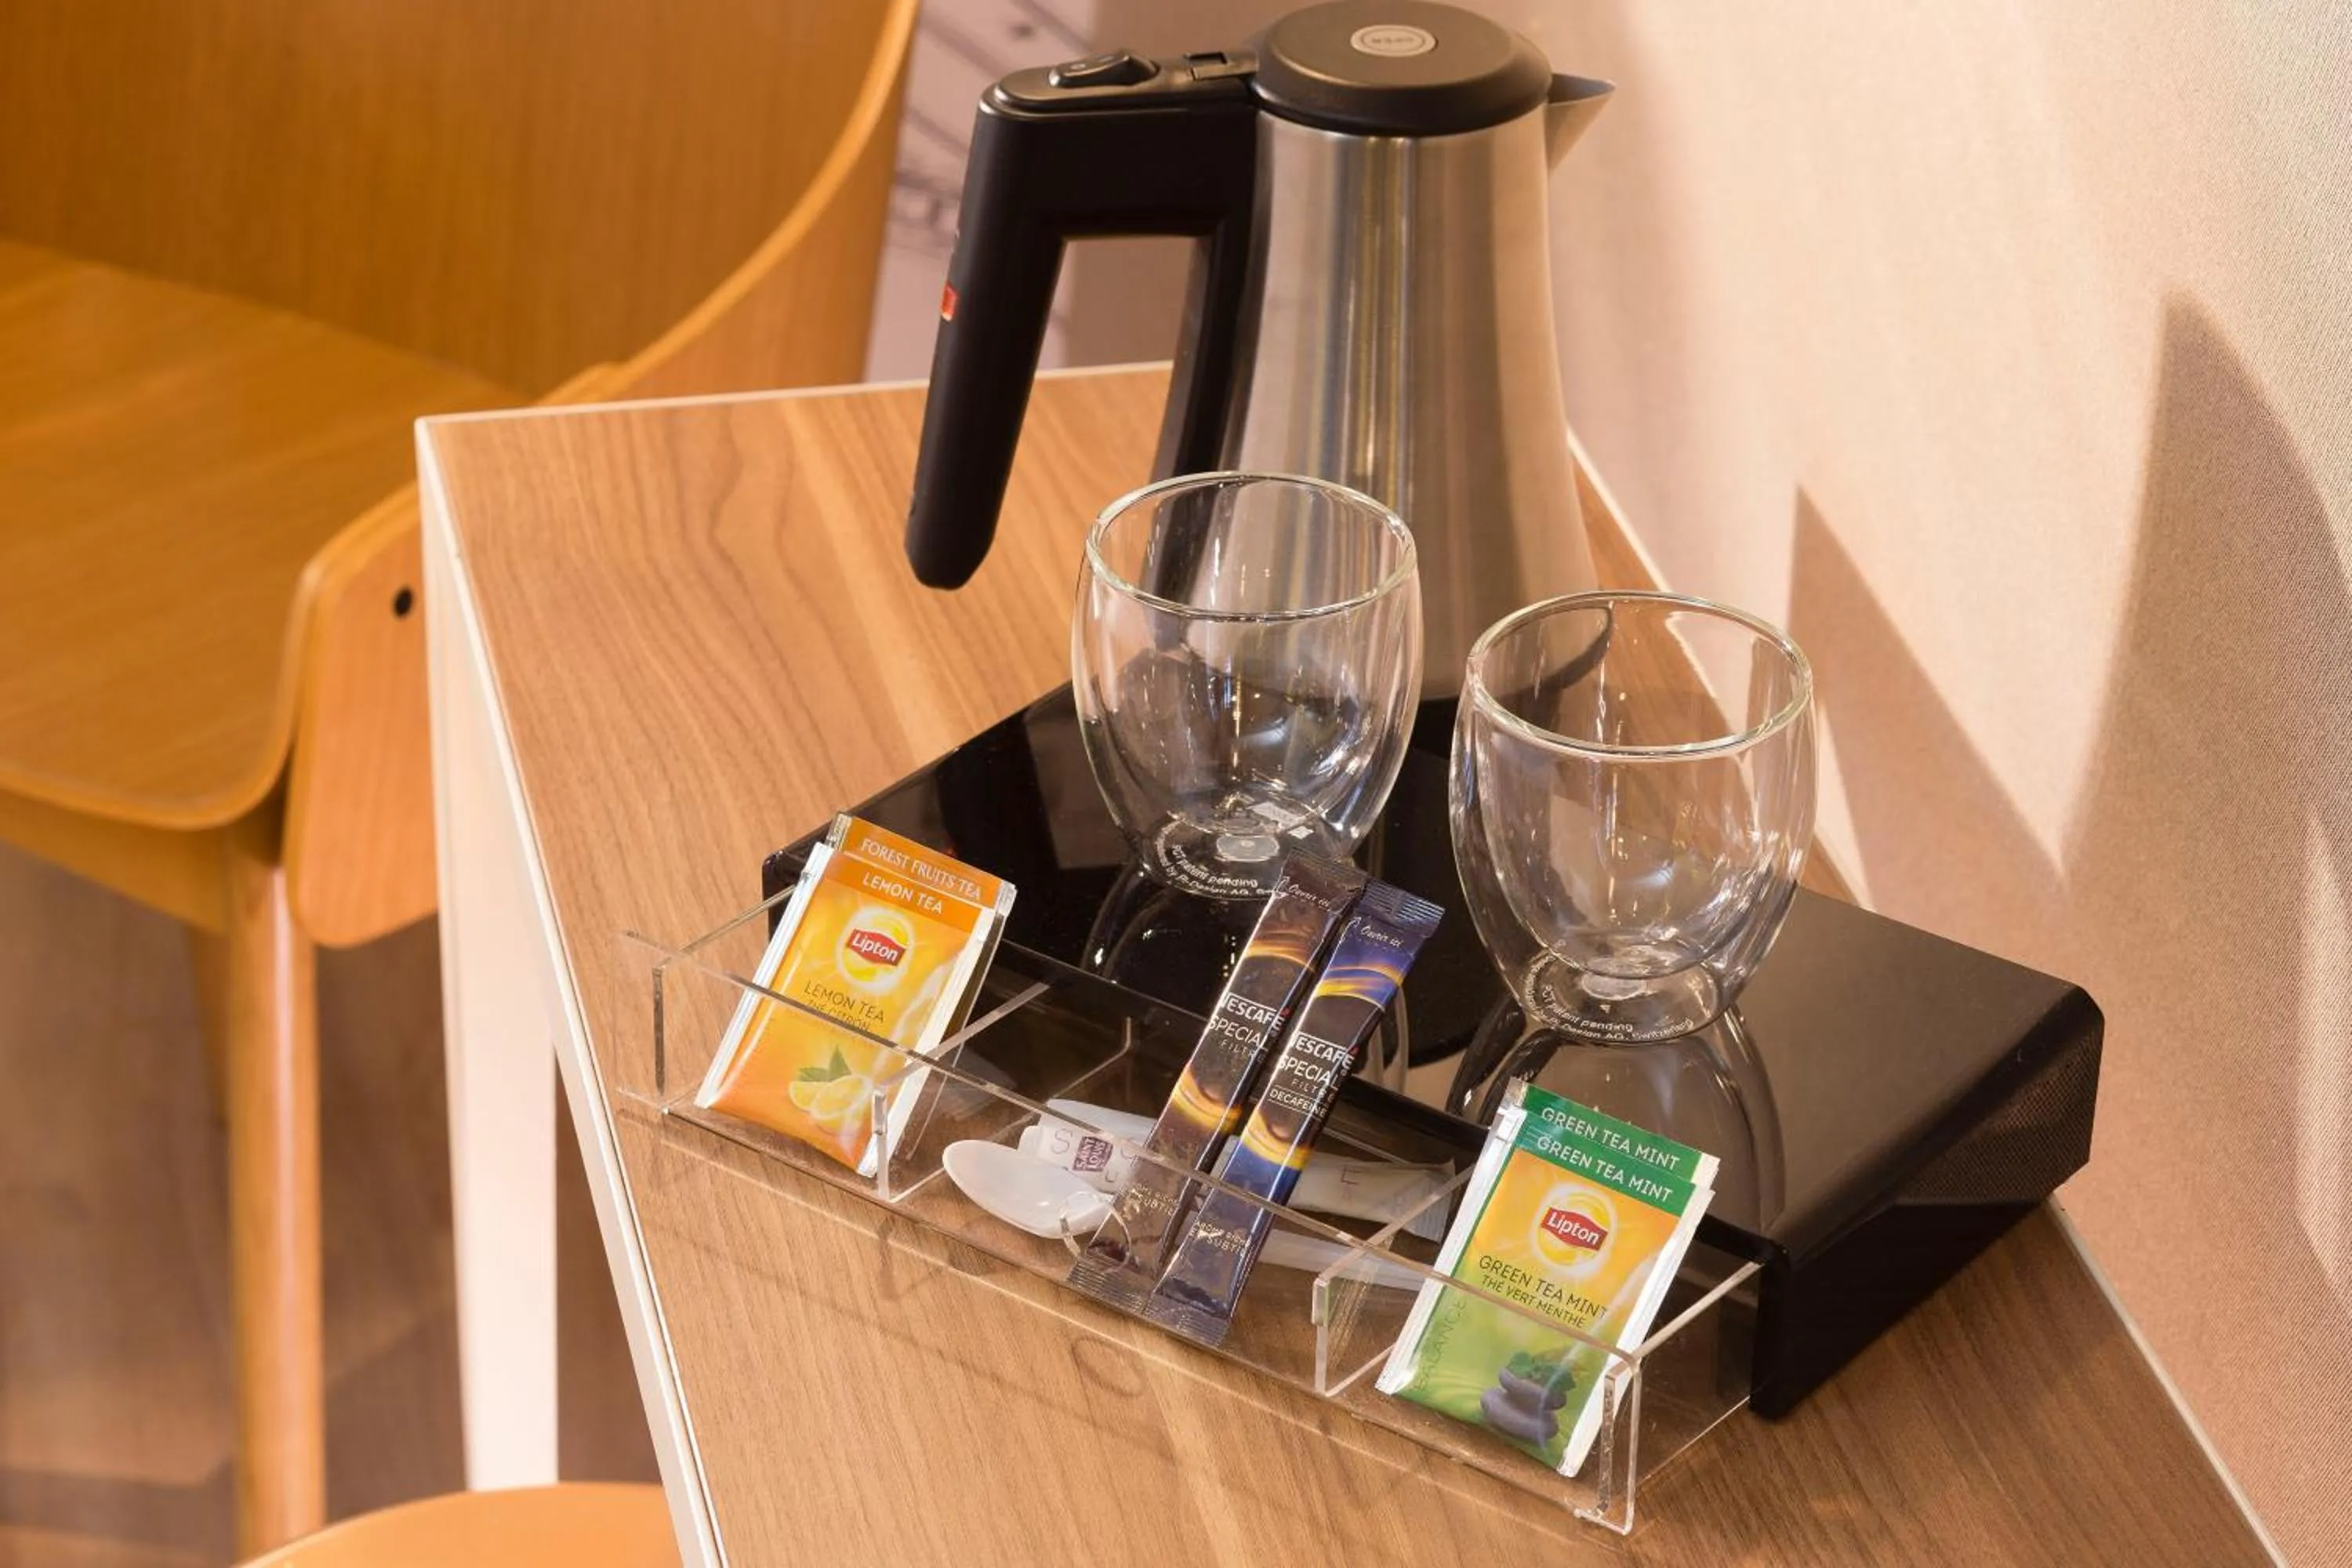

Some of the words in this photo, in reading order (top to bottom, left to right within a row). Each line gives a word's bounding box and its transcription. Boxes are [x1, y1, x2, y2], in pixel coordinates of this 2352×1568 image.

[861, 838, 909, 868] FOREST
[910, 857, 955, 887] FRUITS
[956, 877, 982, 901] TEA
[1207, 873, 1258, 888] pending
[862, 872, 913, 902] LEMON
[916, 893, 942, 915] TEA
[851, 933, 899, 963] Lipton
[804, 981, 855, 1010] LEMON
[861, 1001, 885, 1024] TEA
[1581, 1019, 1634, 1033] pending
[1541, 1107, 1599, 1140] GREEN
[1602, 1129, 1631, 1154] TEA
[1635, 1143, 1680, 1171] MINT
[1537, 1136, 1592, 1169] GREEN
[1595, 1160, 1624, 1185] TEA
[1628, 1174, 1673, 1203] MINT
[1548, 1211, 1600, 1246] Lipton
[1479, 1255, 1533, 1287] GREEN
[1535, 1279, 1563, 1301] TEA
[1566, 1293, 1609, 1319] MINT
[1482, 1274, 1504, 1293] THE
[1505, 1284, 1537, 1305] VERT
[1535, 1299, 1588, 1330] MENTHE
